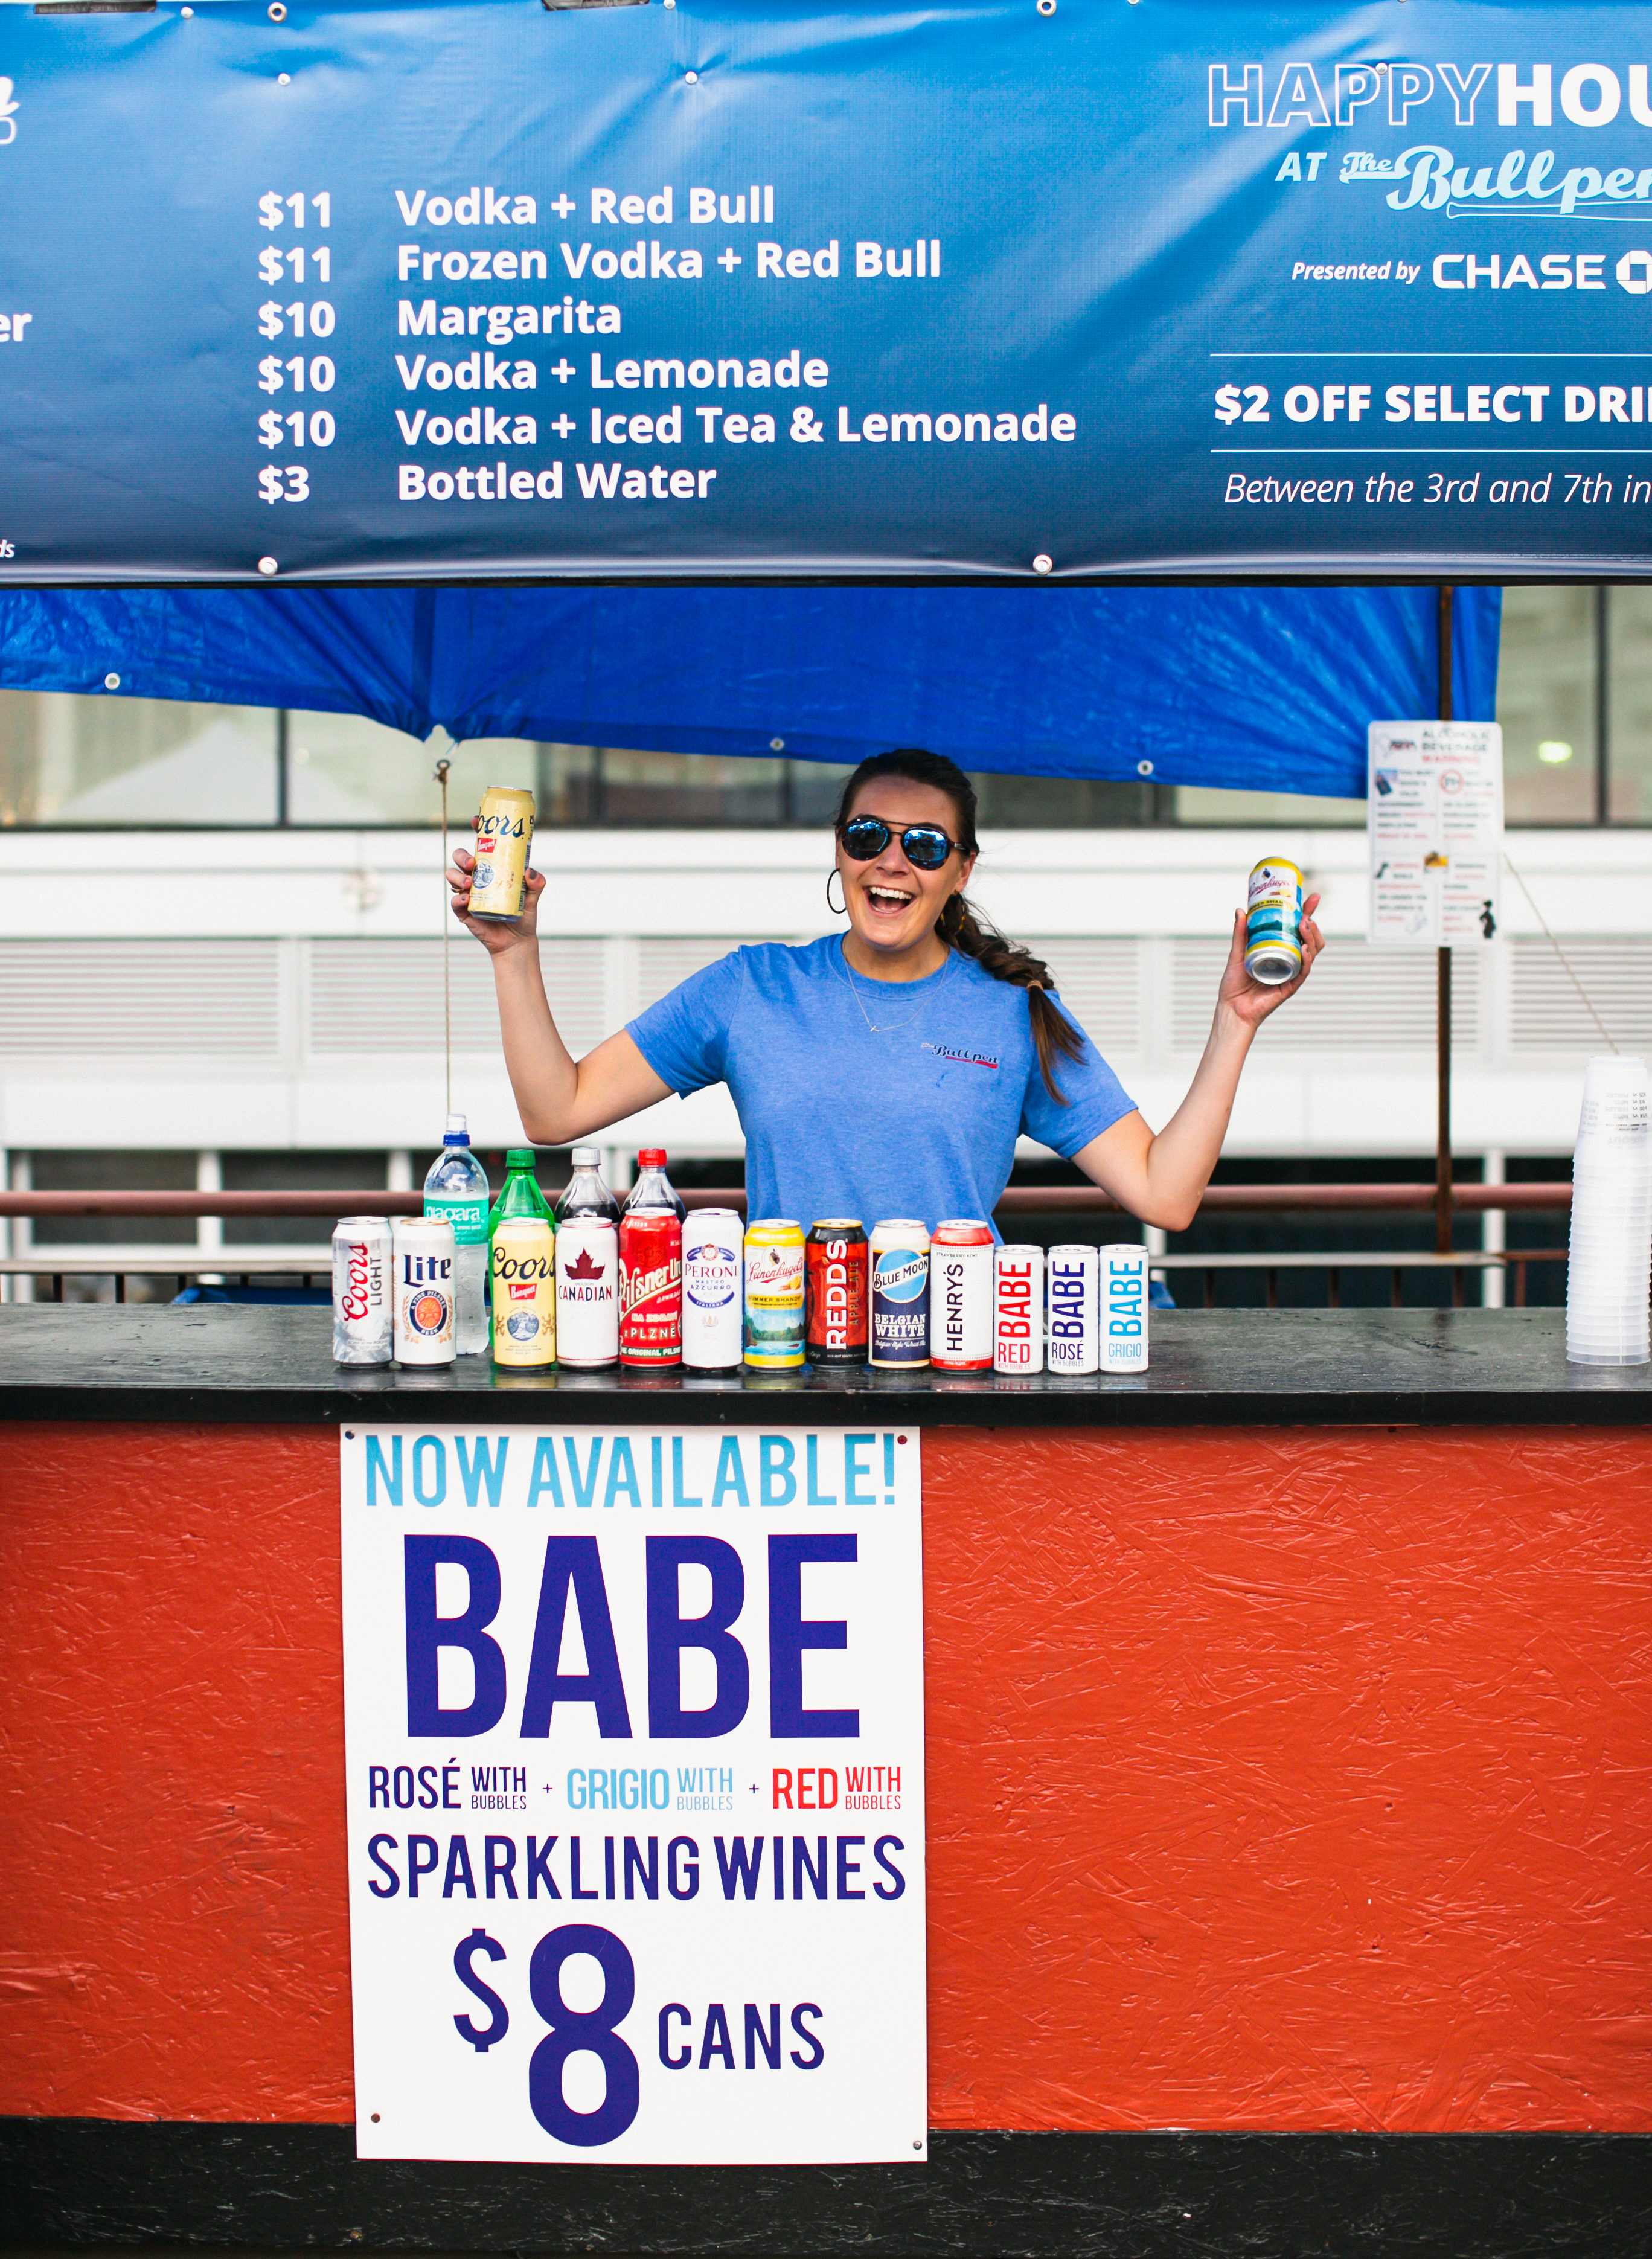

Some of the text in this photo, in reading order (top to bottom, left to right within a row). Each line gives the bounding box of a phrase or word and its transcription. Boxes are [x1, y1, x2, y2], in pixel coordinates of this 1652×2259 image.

[1276, 153, 1327, 181] AT
[1340, 152, 1396, 176] The
[259, 185, 773, 230] $11 Vodka + Red Bull
[259, 240, 940, 285] $11 Frozen Vodka + Red Bull
[1292, 255, 1606, 289] Presented by CHASE
[259, 296, 620, 344] $10 Margarita
[259, 350, 828, 394] $10 Vodka + Lemonade
[1215, 384, 1652, 425] $2 OFF SELECT DRI
[259, 404, 1076, 449] $10 Vodka + Iced Tea & Lemonade
[259, 461, 716, 504] $3 Bottled Water
[1225, 475, 1353, 502] Between
[1366, 472, 1413, 502] the
[1424, 473, 1480, 502] 3rd
[1490, 473, 1552, 502] and
[1565, 473, 1612, 503] 7th
[932, 1045, 999, 1064] Bullpen
[342, 1243, 368, 1321] Coors
[370, 1257, 382, 1306] LIGHT
[403, 1254, 451, 1287] Lite
[493, 1246, 555, 1280] Coors
[685, 1263, 737, 1278] PERONI
[874, 1259, 929, 1290] BLUE MOON
[511, 1284, 536, 1299] Banquet
[559, 1285, 613, 1301] CANADIAN
[848, 1261, 859, 1325] APPLE ALE
[943, 1264, 964, 1351] HENRY'S
[998, 1261, 1031, 1338] BABE
[1052, 1261, 1084, 1338] BABE
[1109, 1260, 1142, 1336] BABE
[874, 1313, 926, 1325] BELGIAN
[875, 1324, 925, 1337] WHITE
[998, 1342, 1031, 1363] RED
[1052, 1340, 1084, 1360] ROSÉ
[1108, 1342, 1142, 1358] GRIGIO
[366, 1433, 894, 1507] NOW AVAILABLE!
[404, 1533, 860, 1738] BABE
[369, 1757, 461, 1809] ROSÉ
[472, 1767, 526, 1792] WITH
[568, 1769, 669, 1809] GRIGIO
[677, 1769, 732, 1792] WITH
[773, 1768, 838, 1809] RED
[845, 1767, 900, 1792] WITH
[472, 1795, 526, 1809] BUBBLES
[846, 1795, 900, 1809] BUBBLES
[678, 1798, 732, 1810] BUBBLES
[368, 1833, 905, 1900] SPARKLING WINES
[659, 2002, 824, 2070] CANS
